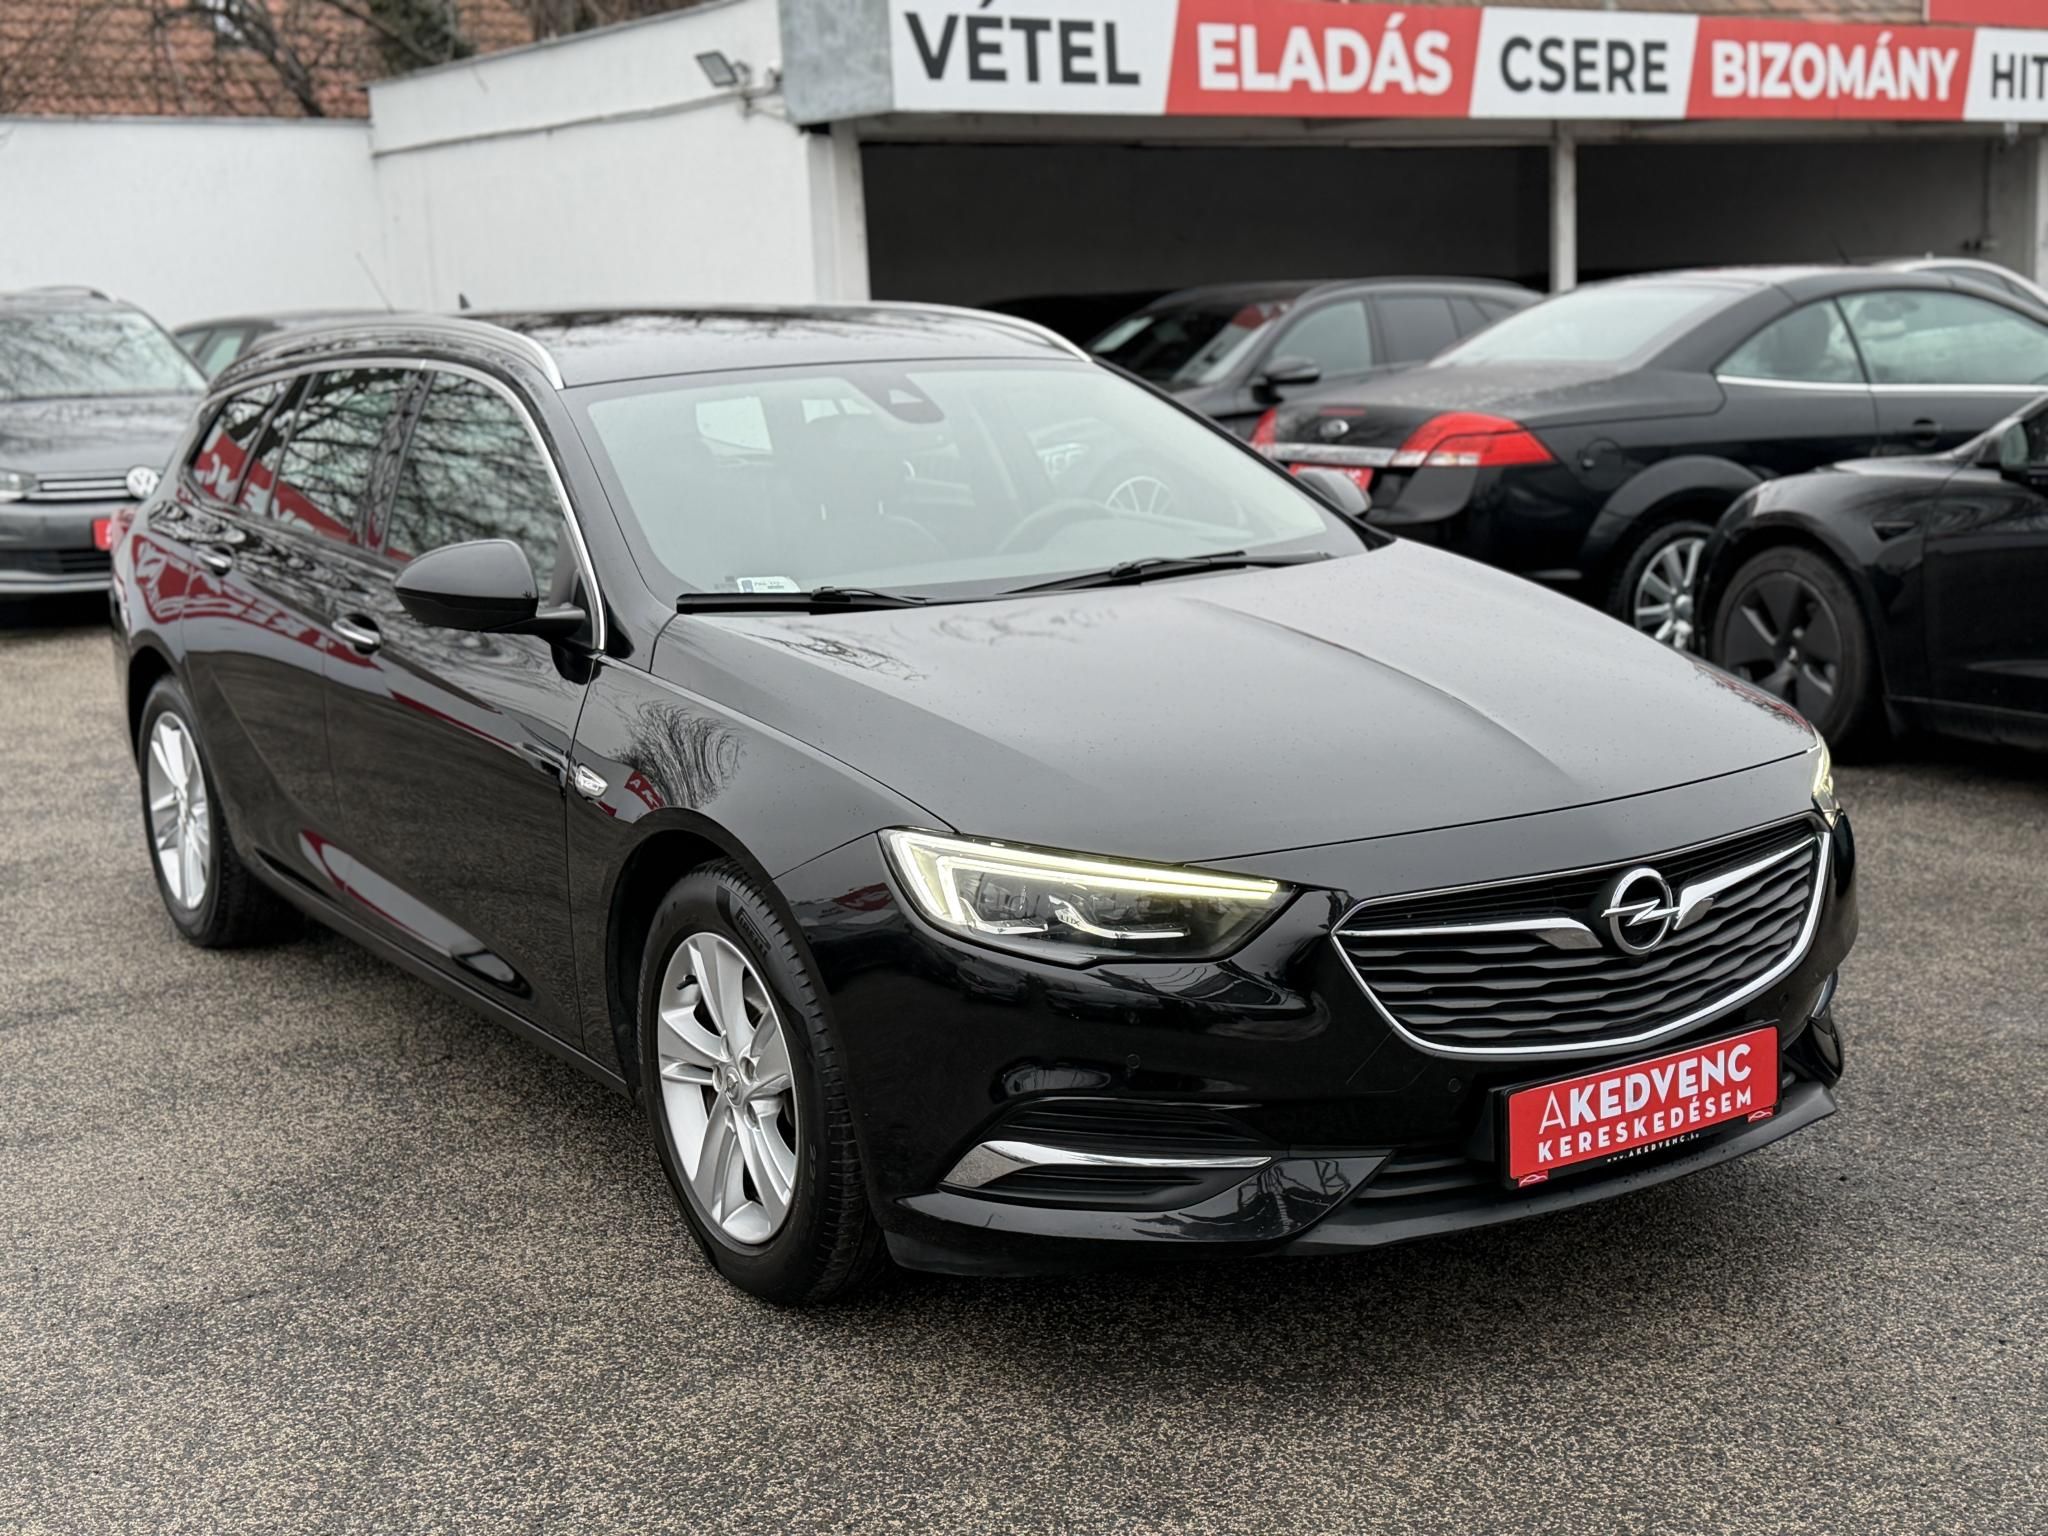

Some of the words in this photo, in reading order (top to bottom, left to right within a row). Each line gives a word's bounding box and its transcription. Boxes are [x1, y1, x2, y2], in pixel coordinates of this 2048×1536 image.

[904, 0, 1141, 86] VÉTEL
[1198, 14, 1454, 96] ELADÁS
[1500, 36, 1669, 94] CSERE
[1711, 32, 1959, 101] BIZOMÁNY
[1538, 1086, 1752, 1163] KERESKEDÉSEM
